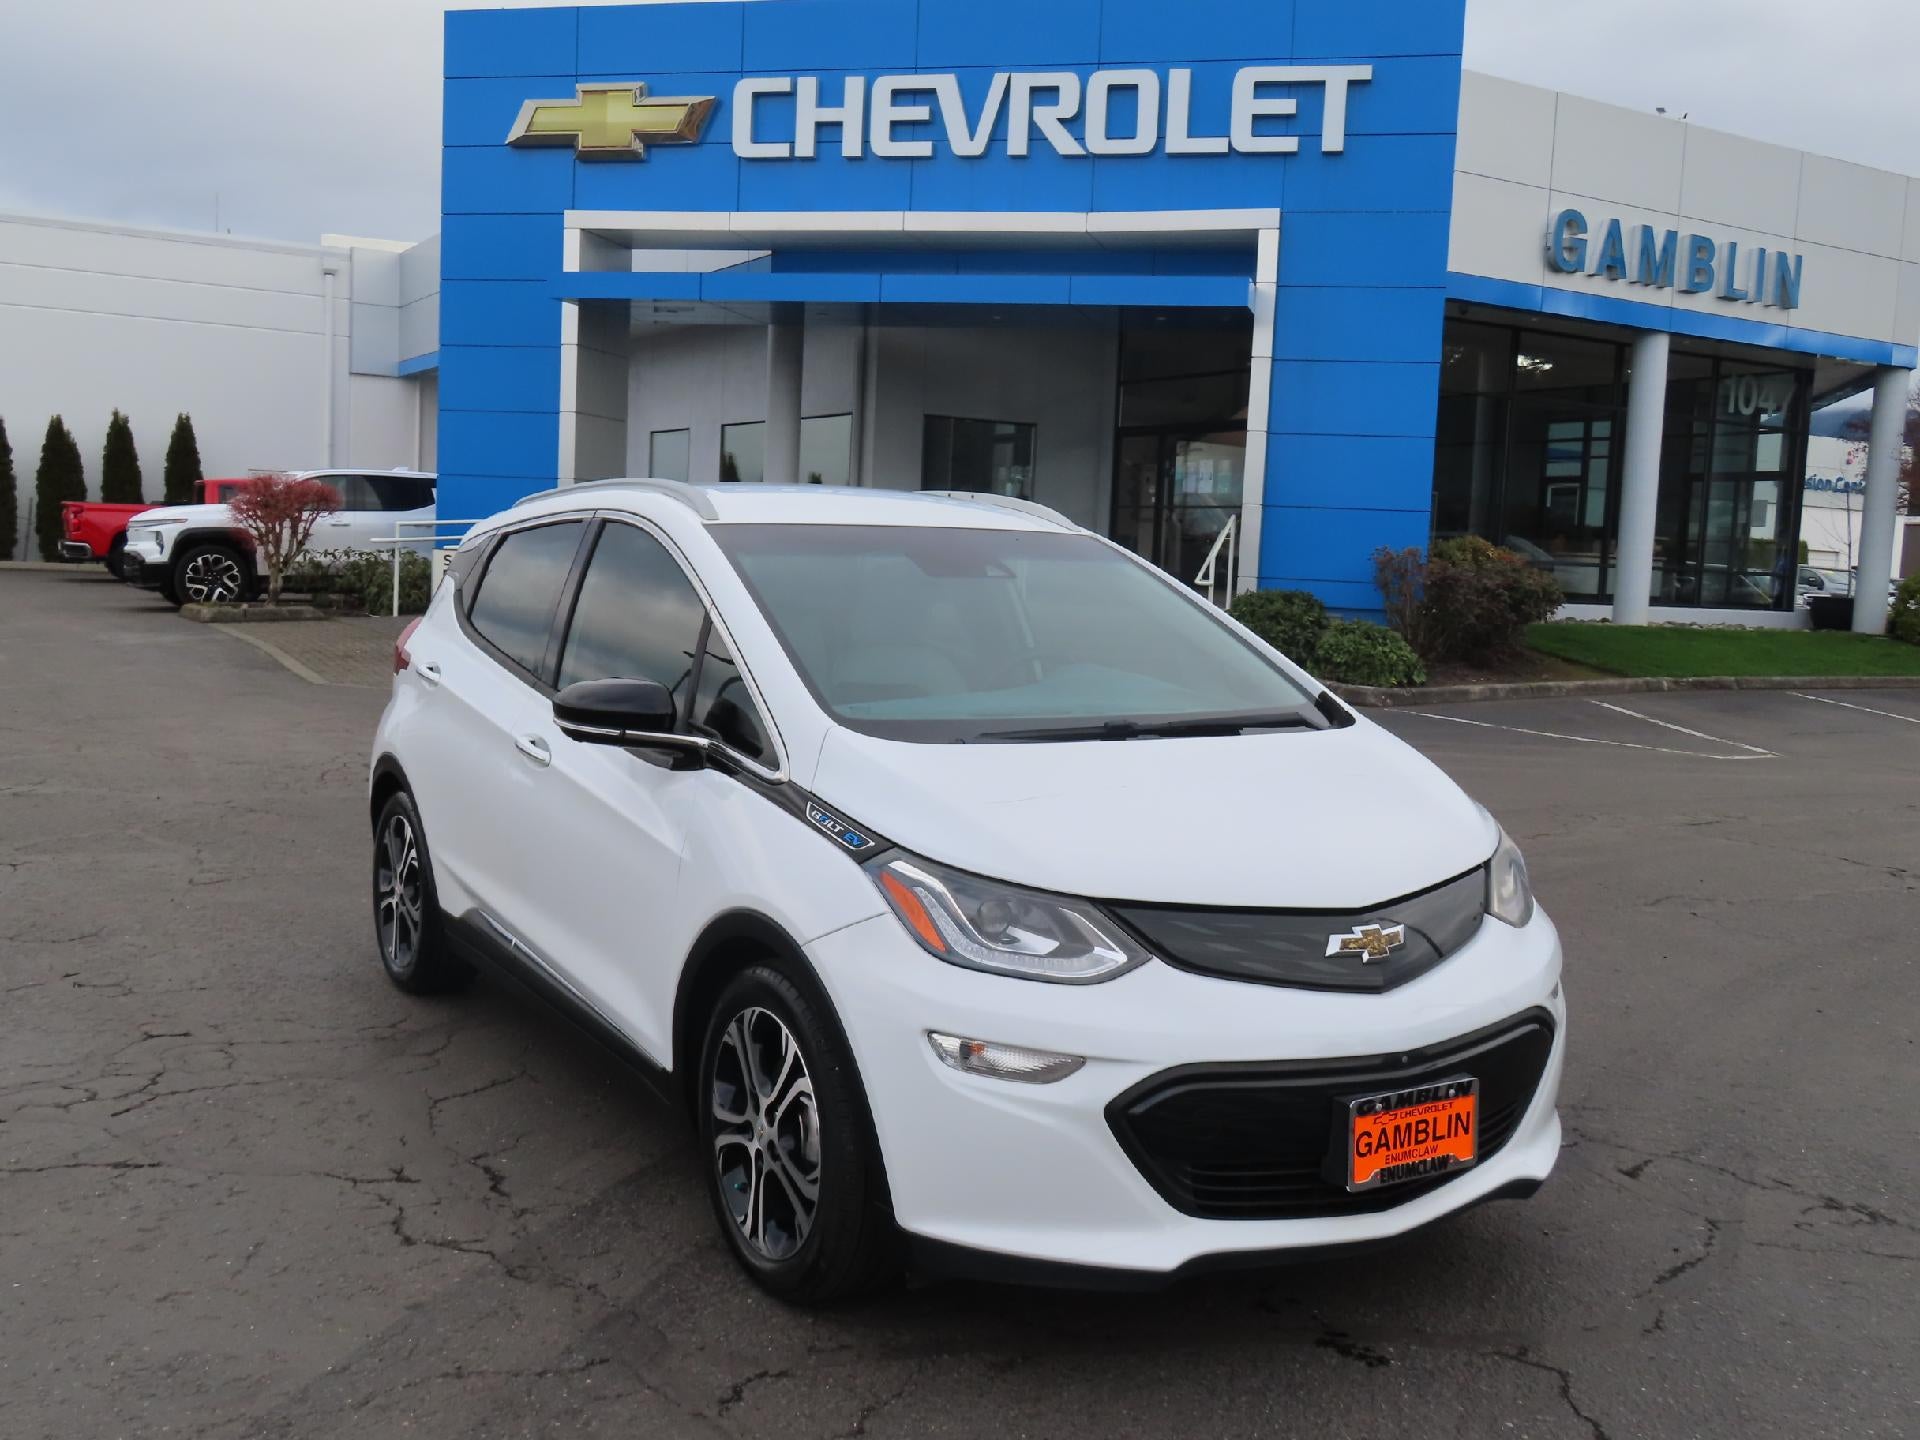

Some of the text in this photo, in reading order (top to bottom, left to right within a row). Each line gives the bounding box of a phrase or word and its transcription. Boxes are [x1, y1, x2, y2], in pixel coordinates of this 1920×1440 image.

[731, 63, 1374, 159] CHEVROLET
[1546, 207, 1803, 310] GAMBLIN
[811, 810, 864, 847] BOLT EV
[1356, 1080, 1473, 1116] GAMBLIN
[1400, 1102, 1454, 1119] CHEVROLET
[1356, 1111, 1471, 1158] GAMBLIN
[1380, 1154, 1450, 1184] ENUMCLAW
[1385, 1144, 1439, 1165] ENUMCLAW
